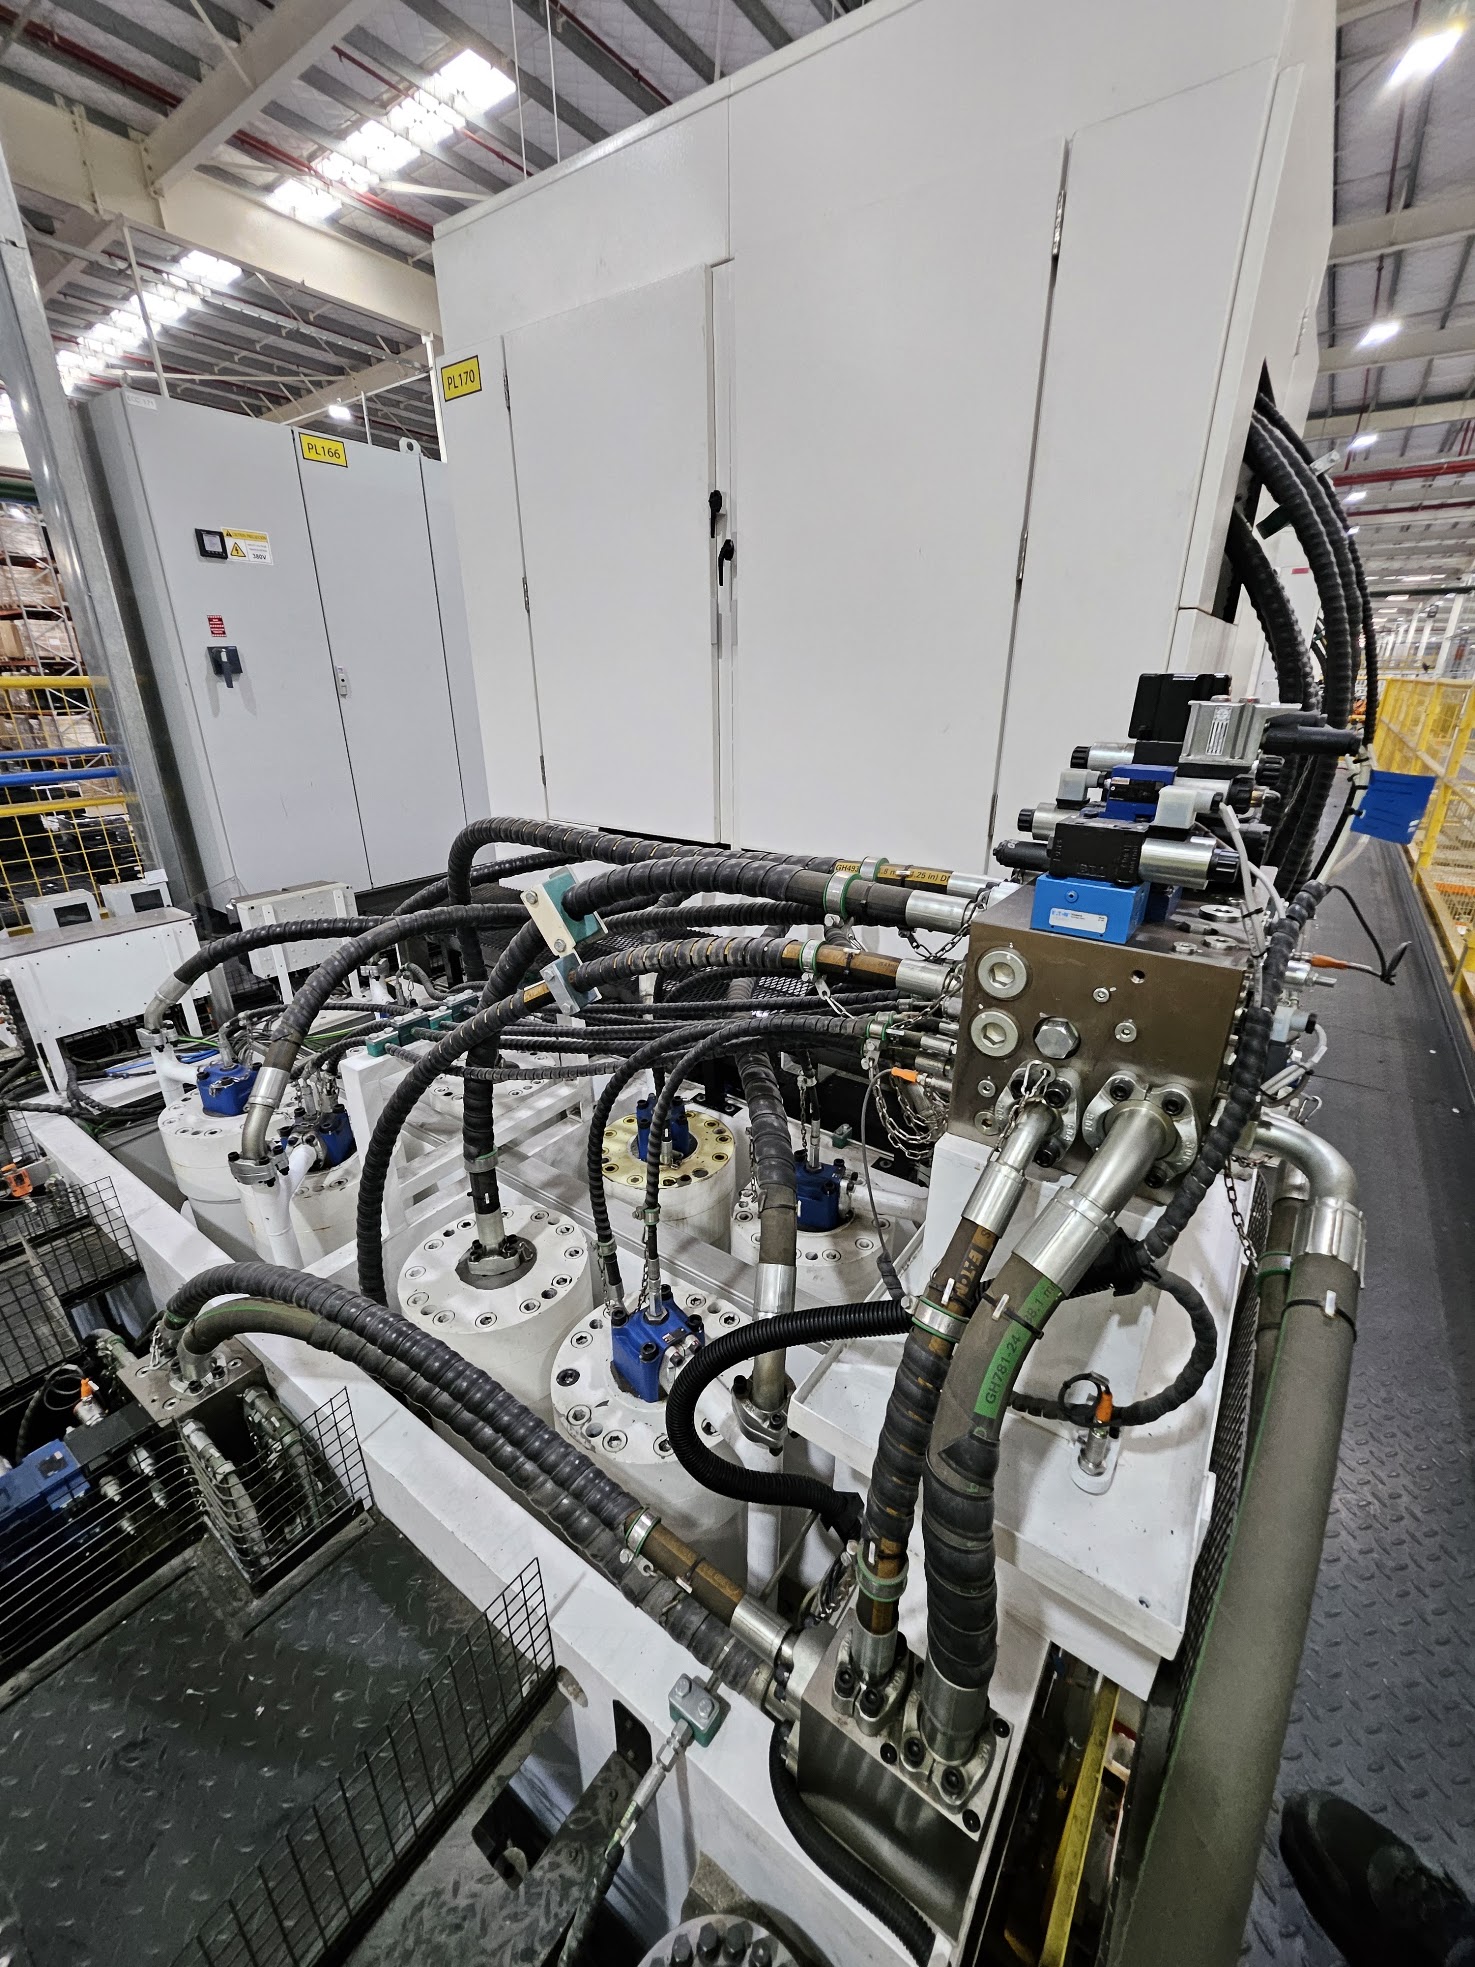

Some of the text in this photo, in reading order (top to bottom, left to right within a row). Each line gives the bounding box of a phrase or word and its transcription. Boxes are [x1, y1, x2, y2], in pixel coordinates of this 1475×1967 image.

[447, 369, 476, 391] PL170
[307, 442, 341, 459] PL166
[836, 864, 860, 873] GH493
[985, 1334, 1022, 1404] GH781-24
